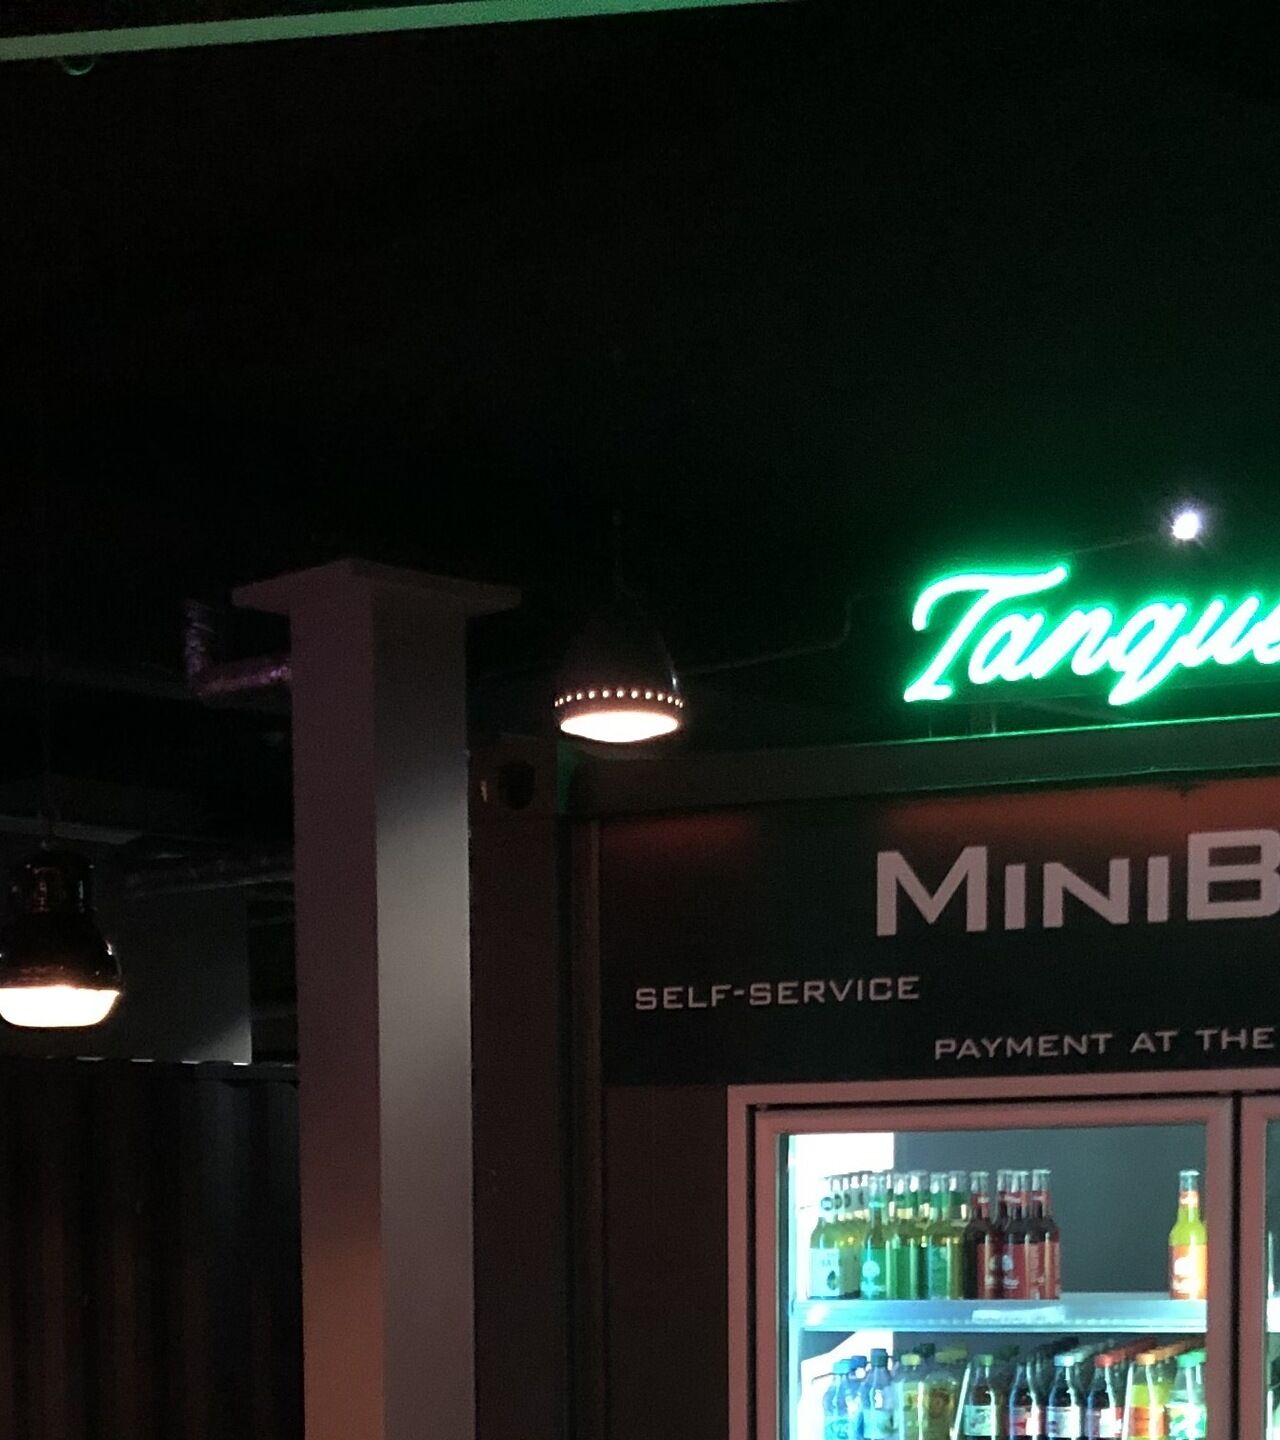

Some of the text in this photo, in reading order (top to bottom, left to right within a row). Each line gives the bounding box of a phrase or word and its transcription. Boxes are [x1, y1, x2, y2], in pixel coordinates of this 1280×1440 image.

[634, 975, 921, 1011] SELF-SERVICE
[933, 1031, 1115, 1062] PAYMENT
[1128, 1029, 1179, 1054] AT
[1194, 1026, 1276, 1052] THE
